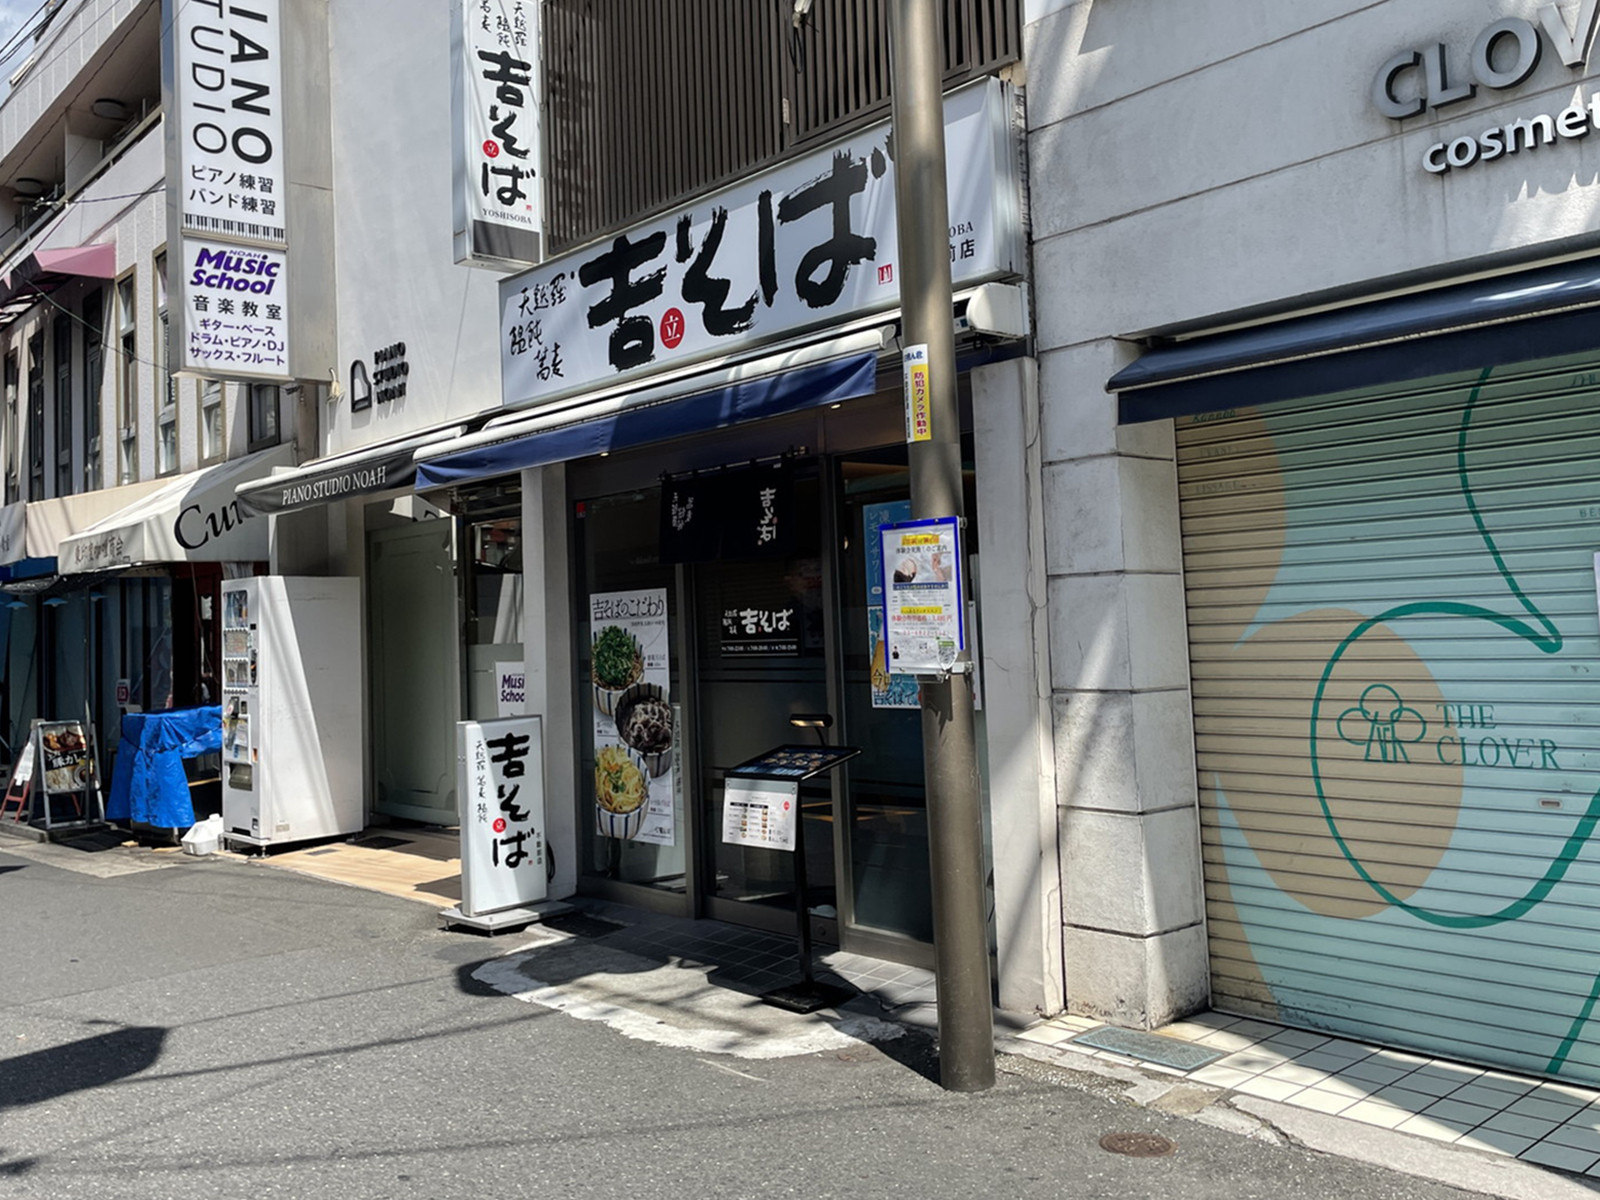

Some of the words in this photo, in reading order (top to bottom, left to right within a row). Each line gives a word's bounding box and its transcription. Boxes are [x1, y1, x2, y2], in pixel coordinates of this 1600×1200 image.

[477, 50, 536, 207] 吉そば
[192, 165, 274, 194] ピアノ練習
[190, 188, 276, 216] バンド練習
[482, 208, 532, 224] YOSHISOBA
[195, 248, 281, 277] Music
[229, 250, 261, 259] NOAH
[579, 128, 894, 372] 吉そば
[190, 269, 275, 295] School
[193, 295, 282, 321] 音楽教室
[200, 318, 276, 337] ギター・ベース
[191, 332, 285, 352] ドラム・ピアノ・DJ
[190, 347, 285, 366] サックス・フルート
[914, 371, 927, 435] 防犯カメラ作動中
[282, 485, 312, 506] PIANO
[313, 475, 350, 499] STUDIO
[352, 466, 387, 490] NOAH
[740, 608, 793, 635] 吉そば
[1436, 704, 1498, 729] THE
[1436, 736, 1562, 770] CLOVER
[486, 733, 535, 868] 吉そば
